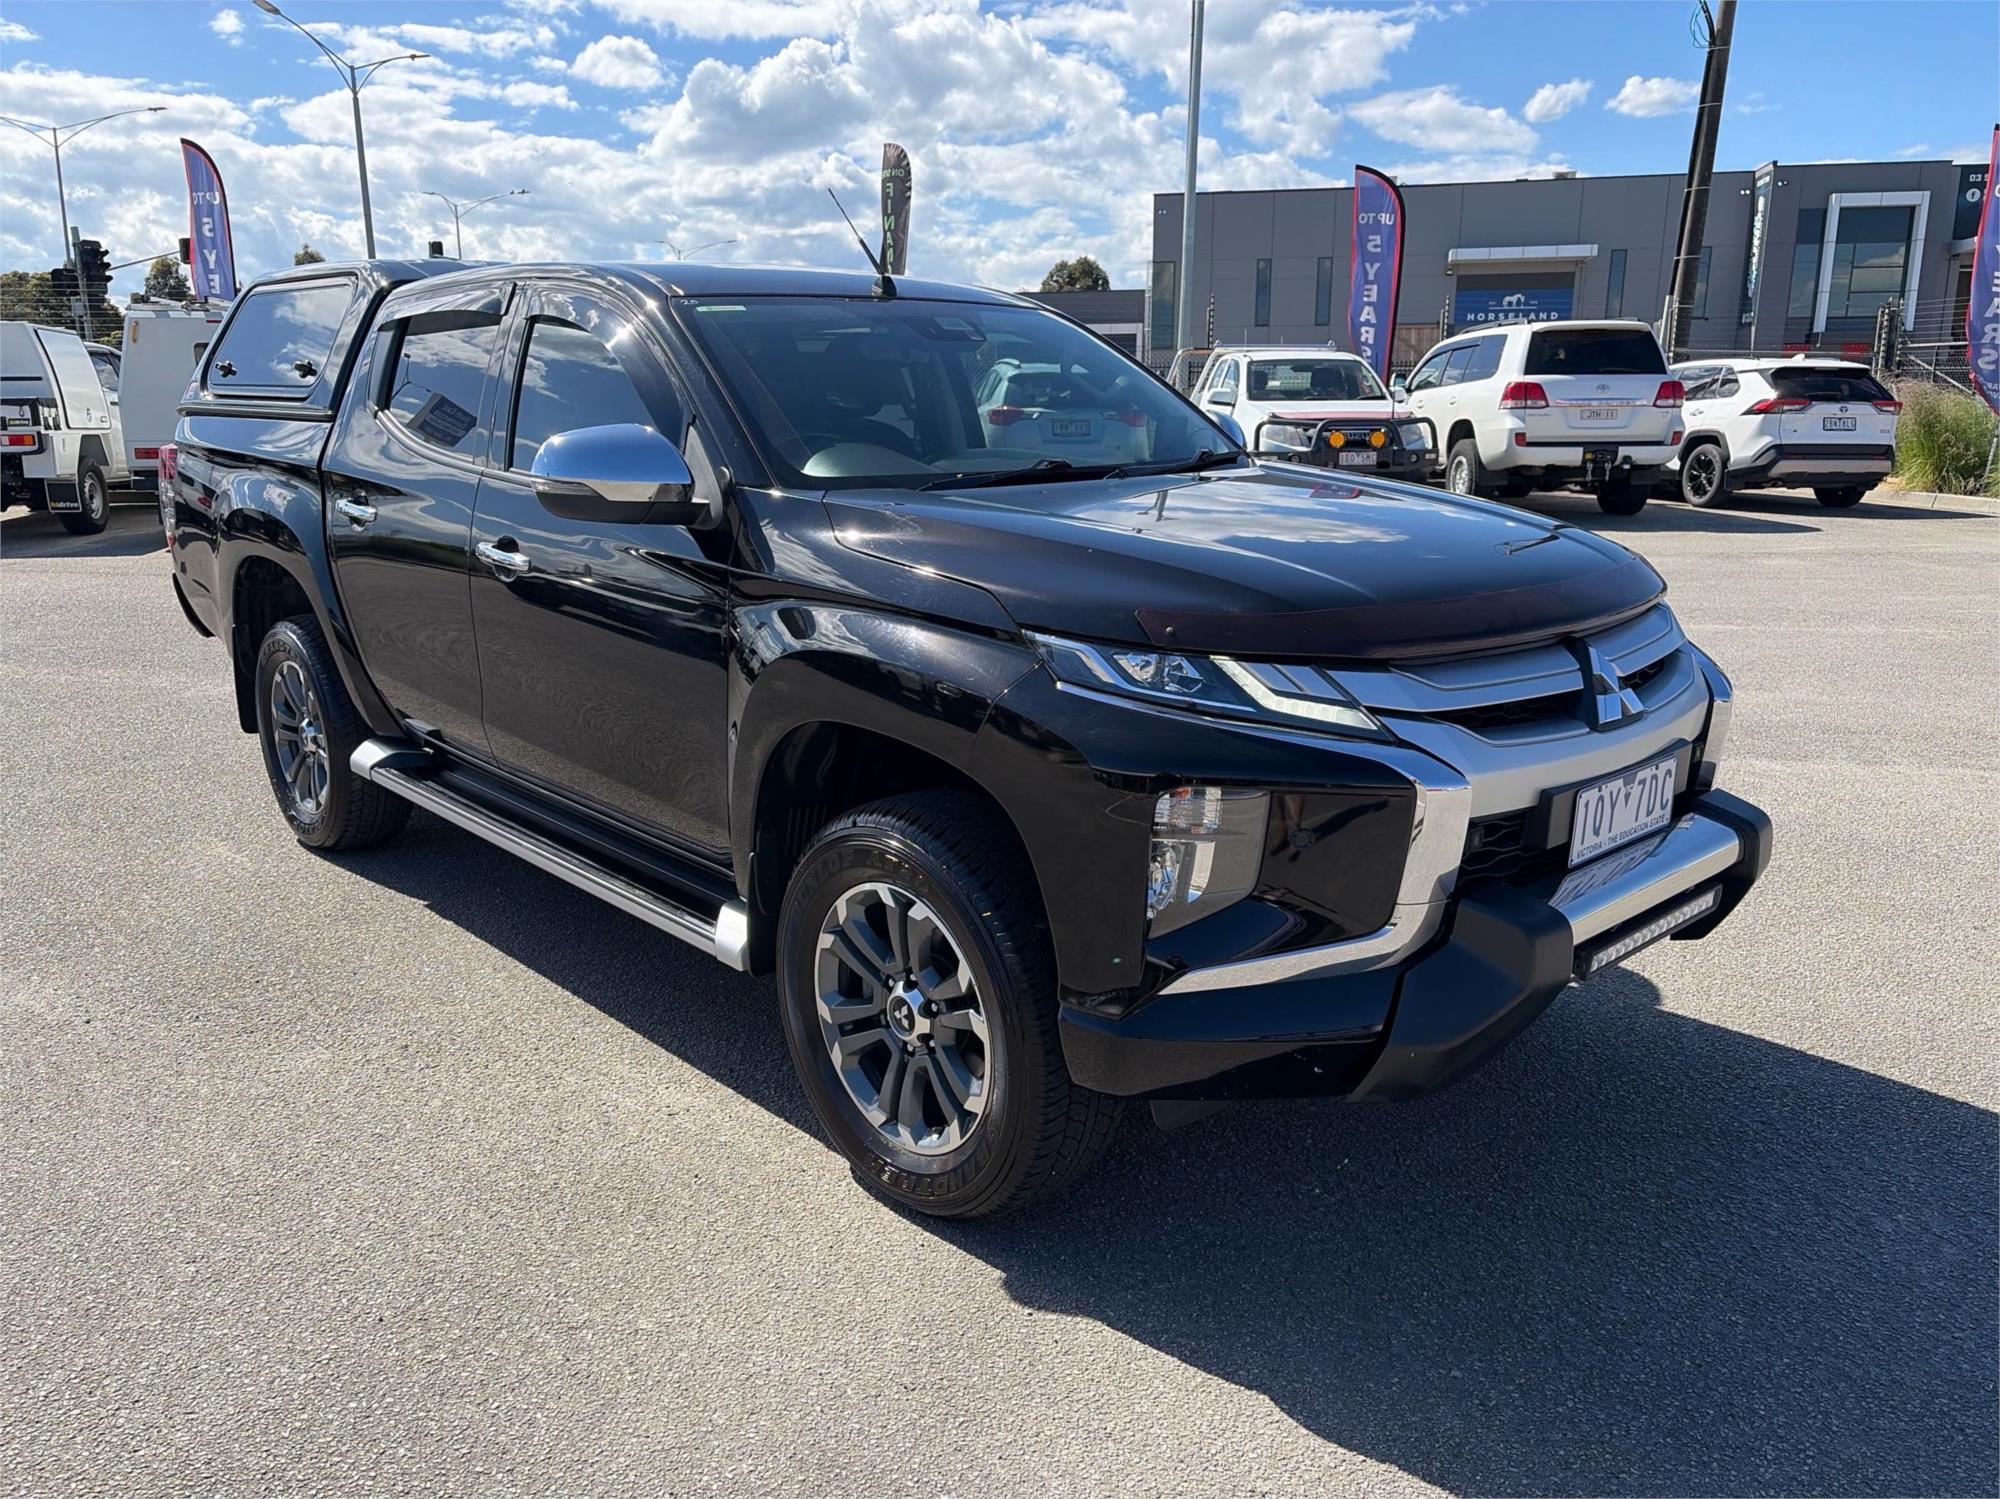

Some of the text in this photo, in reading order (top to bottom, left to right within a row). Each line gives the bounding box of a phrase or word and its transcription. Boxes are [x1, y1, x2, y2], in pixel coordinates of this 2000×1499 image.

[1466, 311, 1559, 321] HORSELAND
[1634, 768, 1673, 823] 7DC
[1576, 840, 1603, 859] VICTORIA
[1607, 834, 1618, 846] THE
[1618, 822, 1649, 841] EDUCATION
[1650, 814, 1666, 828] STATE
